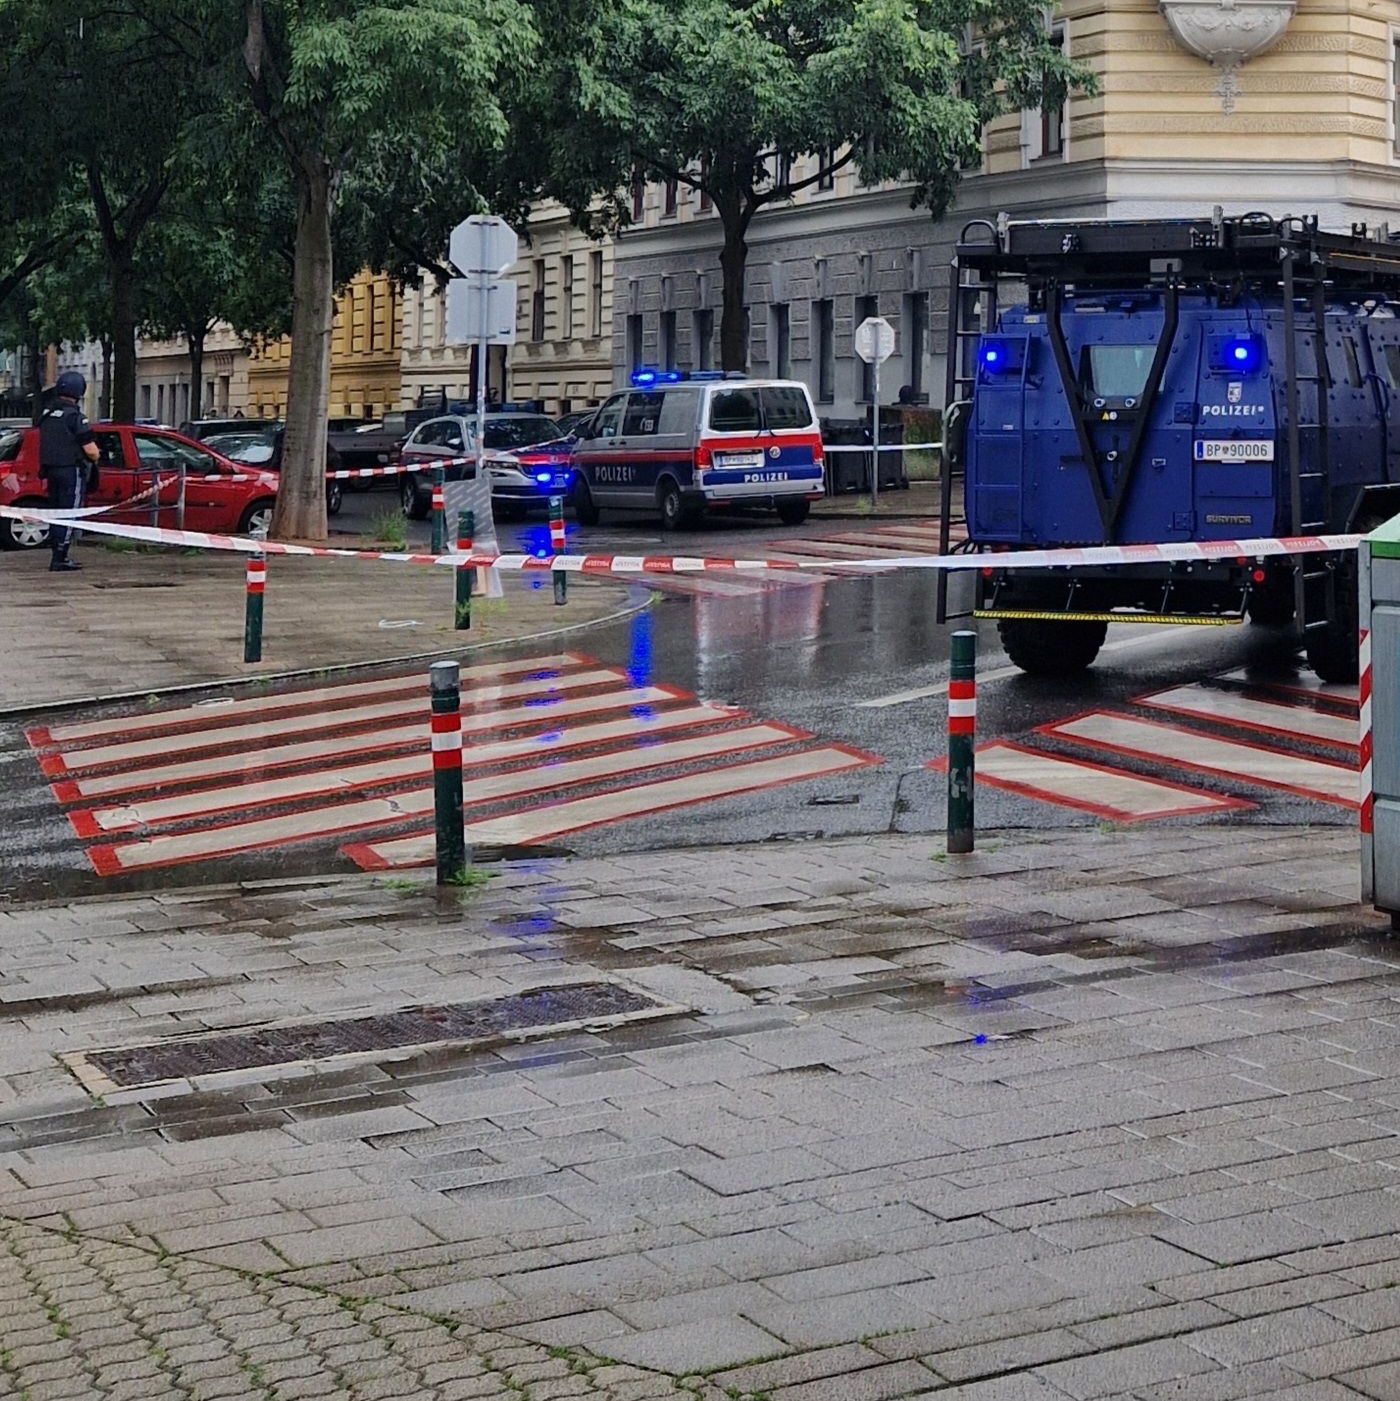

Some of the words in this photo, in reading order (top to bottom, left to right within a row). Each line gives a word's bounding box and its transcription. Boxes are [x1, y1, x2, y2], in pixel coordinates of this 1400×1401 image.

[1202, 405, 1256, 416] POLIZEI
[1206, 444, 1221, 457] BP
[1229, 444, 1268, 457] 90006
[595, 466, 633, 482] POLIZEI
[744, 472, 788, 483] POLIZEI
